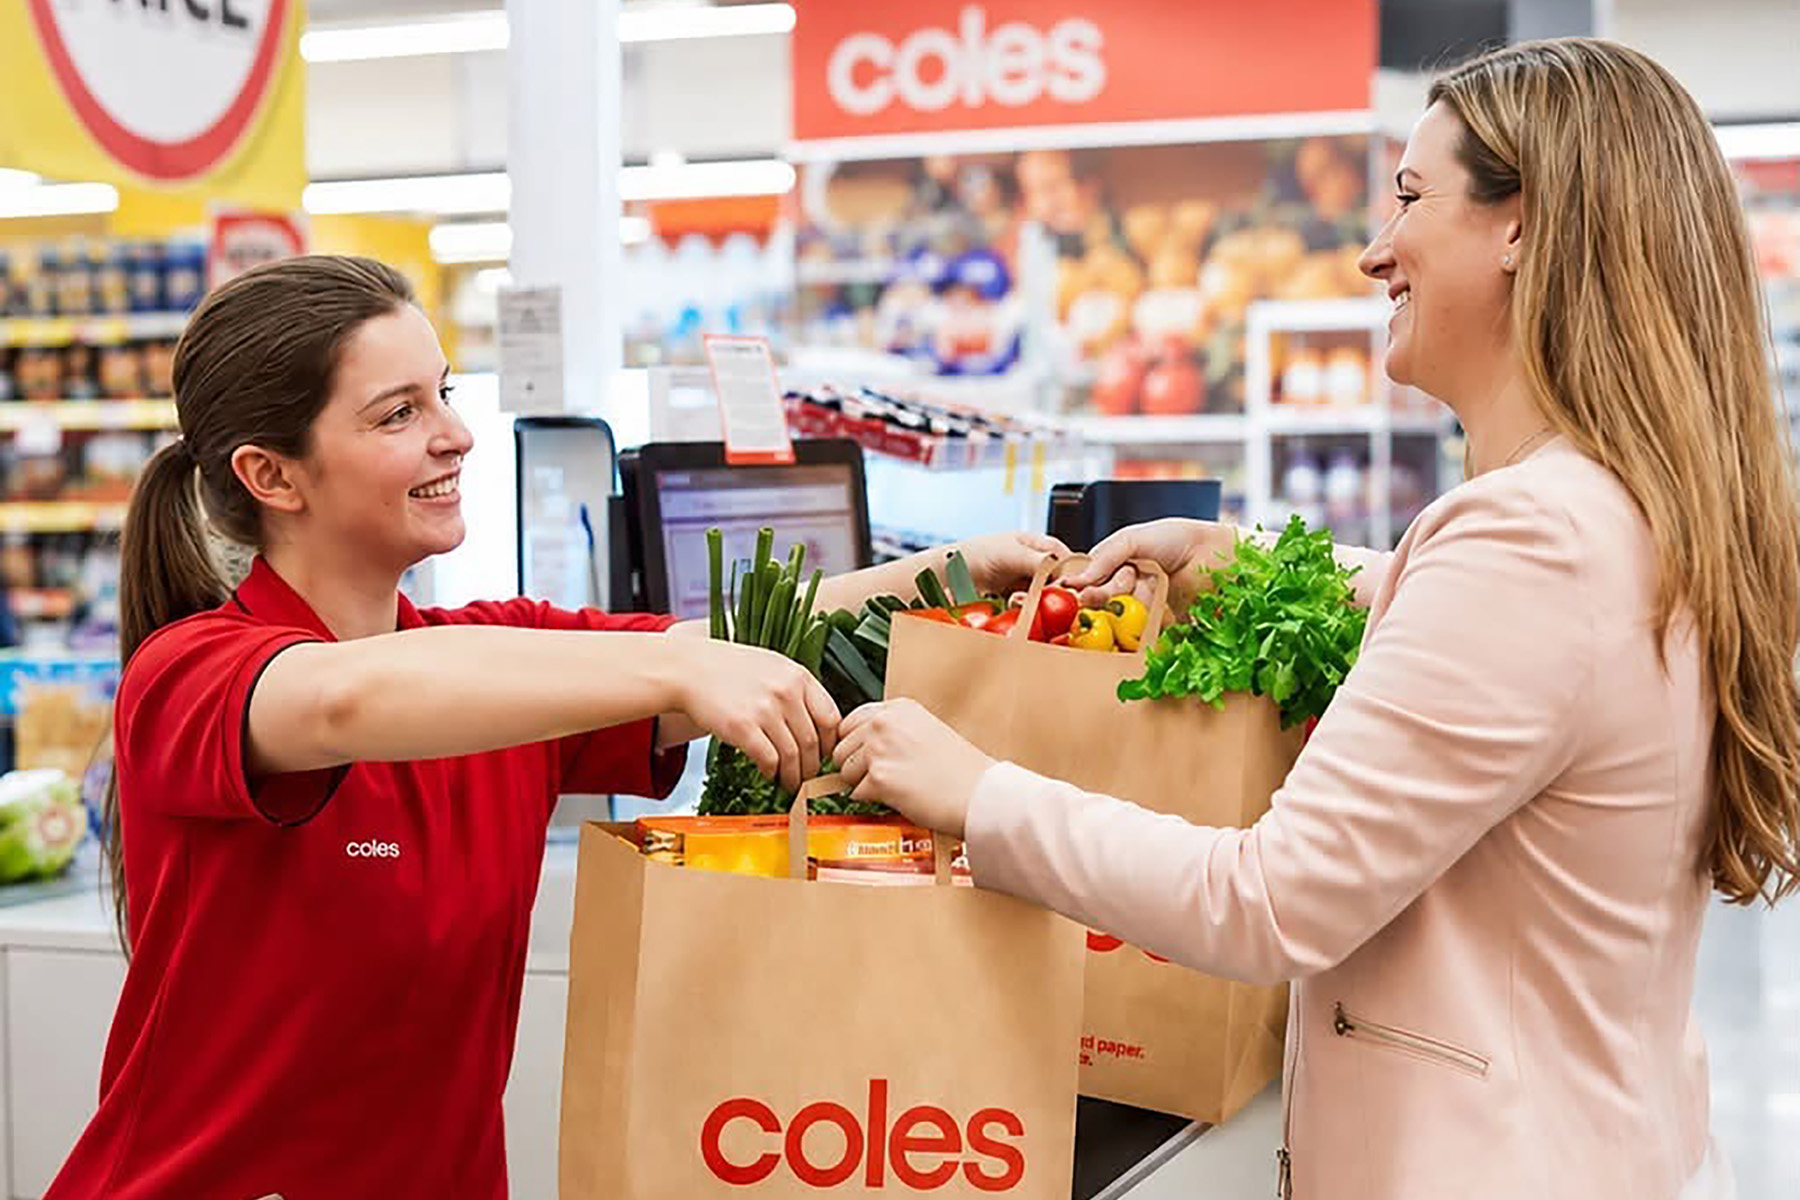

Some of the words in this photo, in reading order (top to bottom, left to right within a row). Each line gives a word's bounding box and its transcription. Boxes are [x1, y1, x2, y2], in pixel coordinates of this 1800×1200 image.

[827, 5, 1106, 116] coles
[346, 839, 400, 858] coles
[1097, 1040, 1144, 1059] paper.
[701, 1079, 1025, 1192] coles
